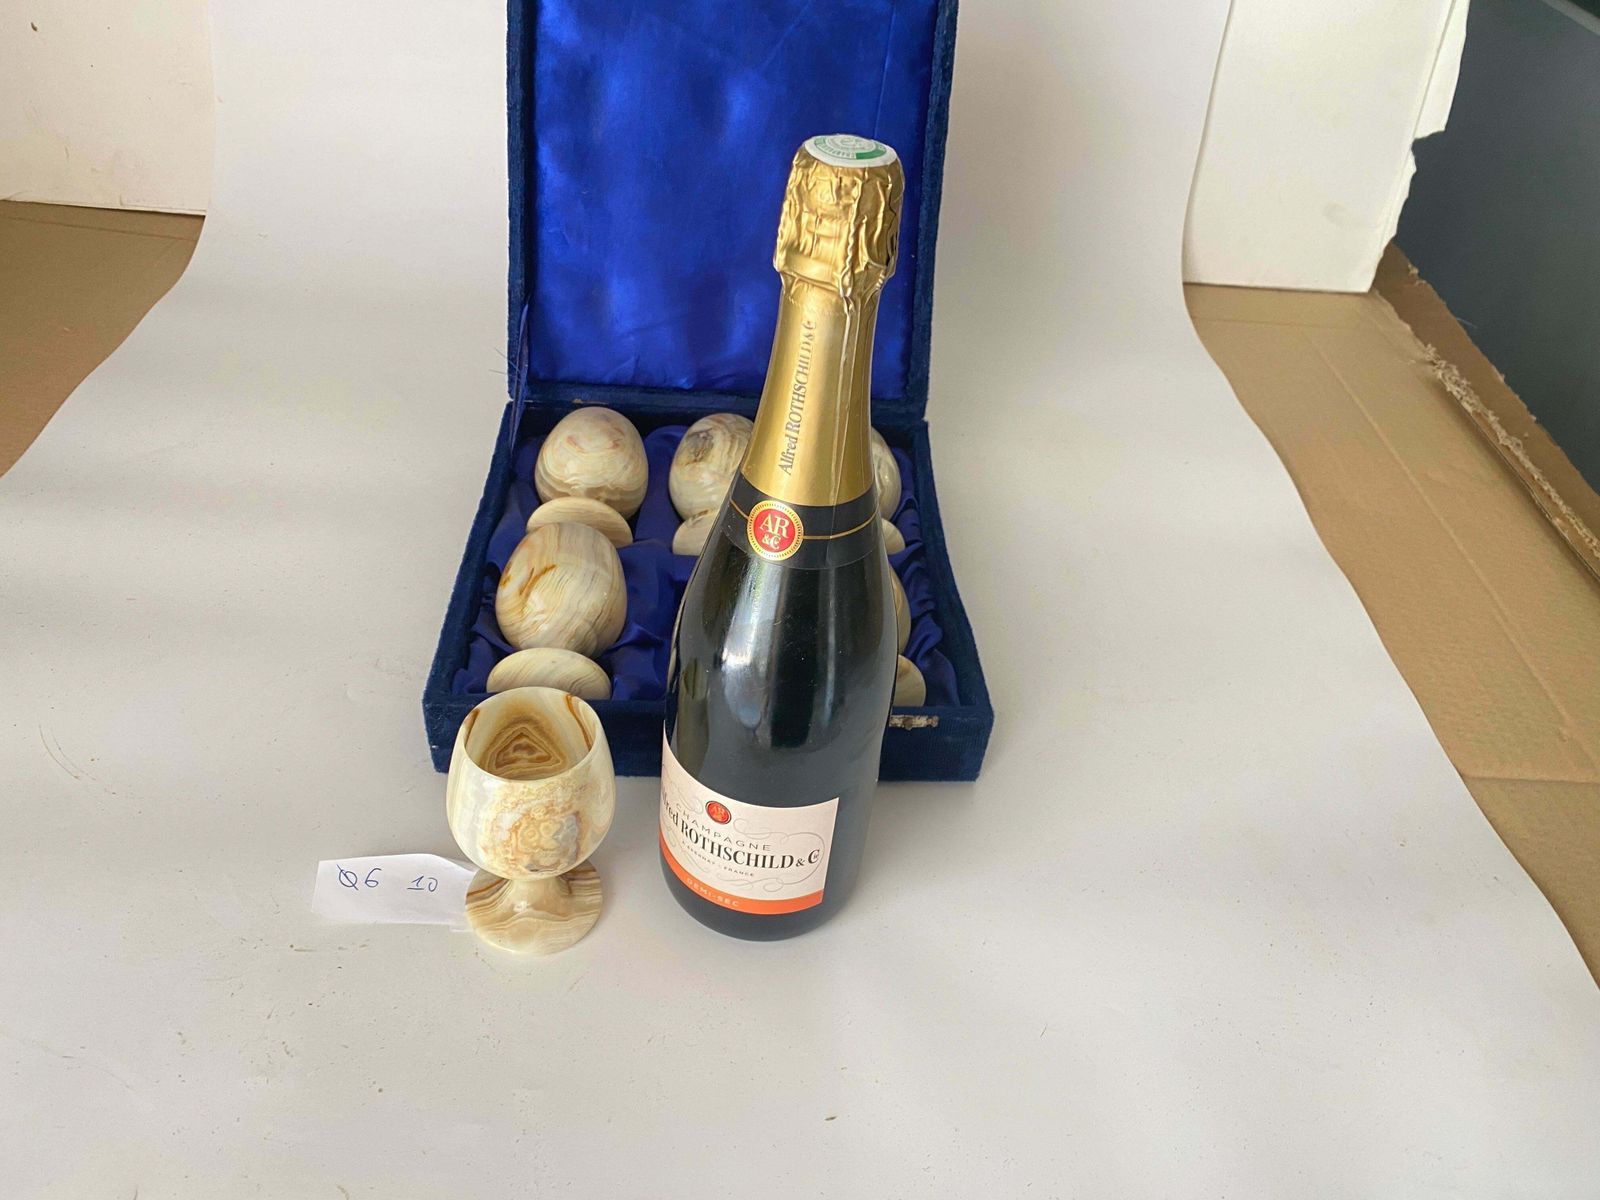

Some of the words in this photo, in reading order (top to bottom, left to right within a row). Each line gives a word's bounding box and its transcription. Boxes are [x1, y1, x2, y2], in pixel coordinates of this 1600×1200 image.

[785, 343, 814, 436] ROTHSCHILD
[777, 433, 799, 476] Alfred
[759, 512, 790, 539] AR
[676, 802, 771, 852] CHAMPAGNE
[681, 820, 794, 869] ROTHSCHILD
[795, 857, 805, 867] &
[407, 875, 439, 893] 10
[723, 866, 755, 877] FRANCE
[686, 877, 740, 908] DEMI-SEC
